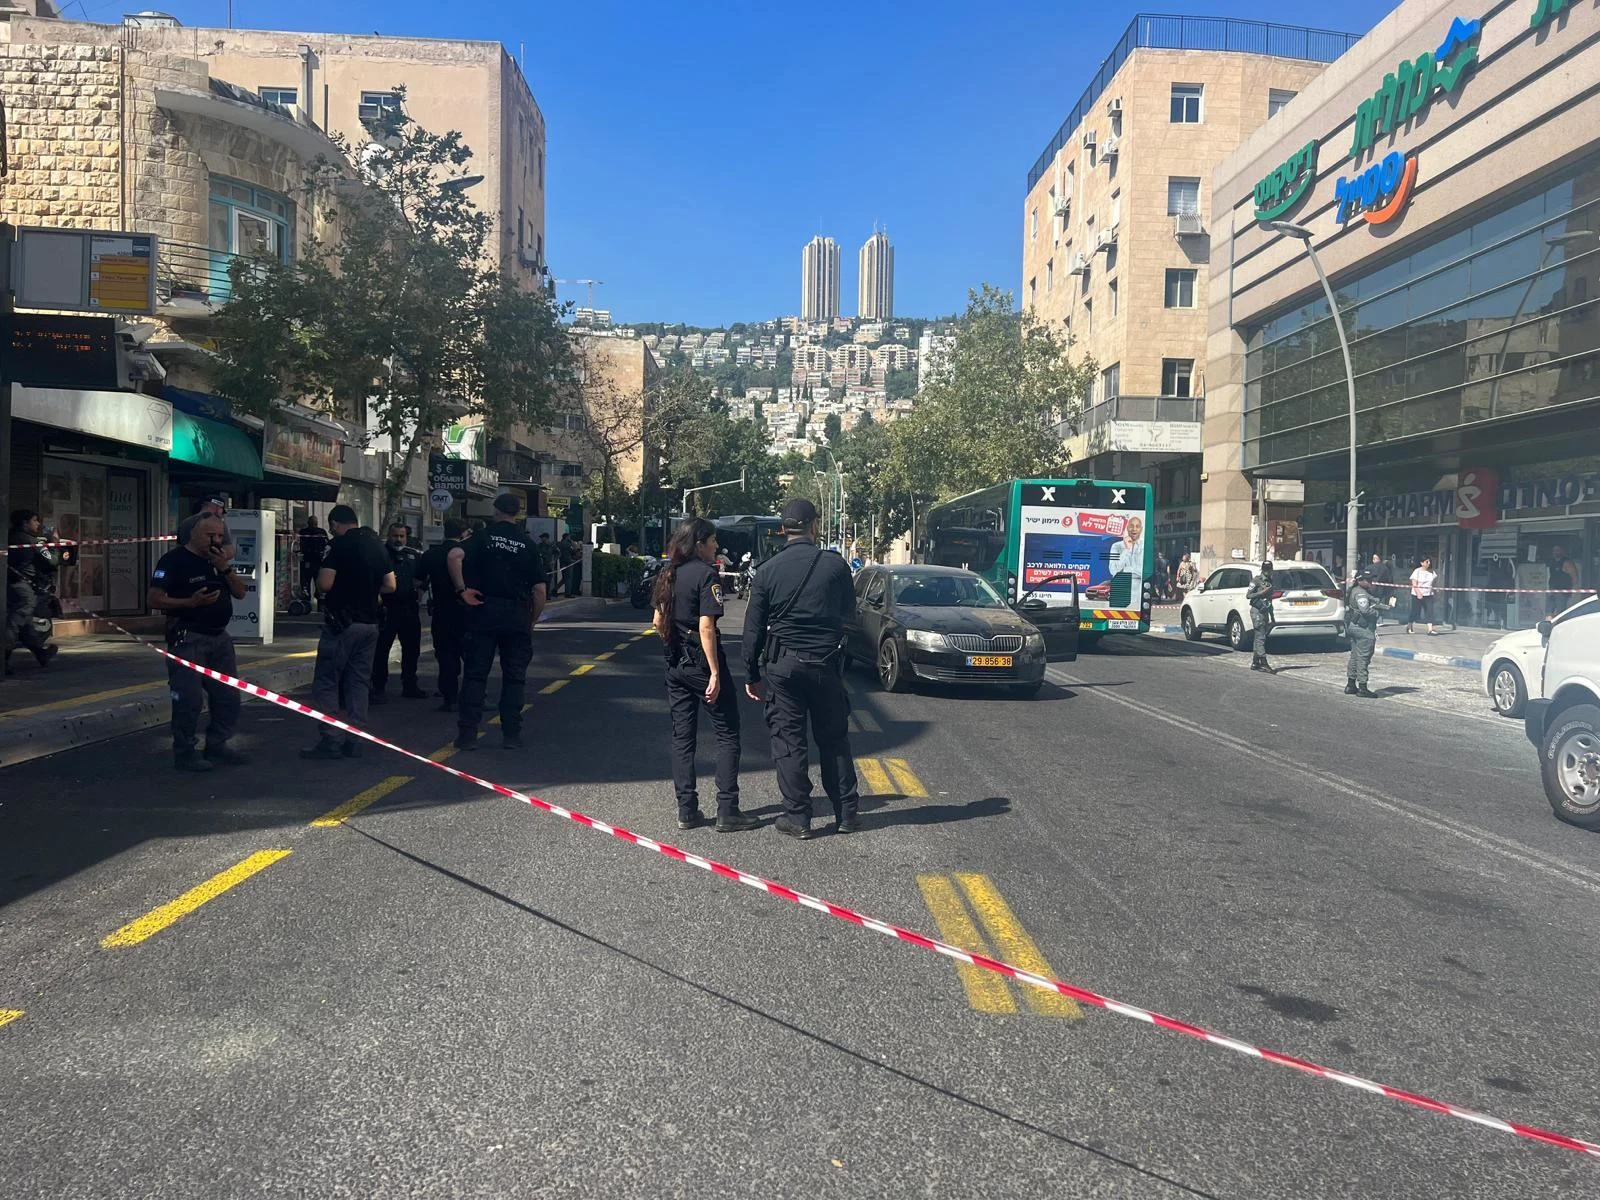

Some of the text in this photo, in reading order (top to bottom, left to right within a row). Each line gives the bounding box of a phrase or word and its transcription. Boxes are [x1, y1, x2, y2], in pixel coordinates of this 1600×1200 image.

[1349, 51, 1438, 157] כללית
[433, 474, 464, 483] обмен
[495, 541, 519, 554] POLICE
[1044, 562, 1067, 570] הלוואה
[1068, 562, 1091, 571] לוקחים
[1033, 568, 1052, 576] לשלם
